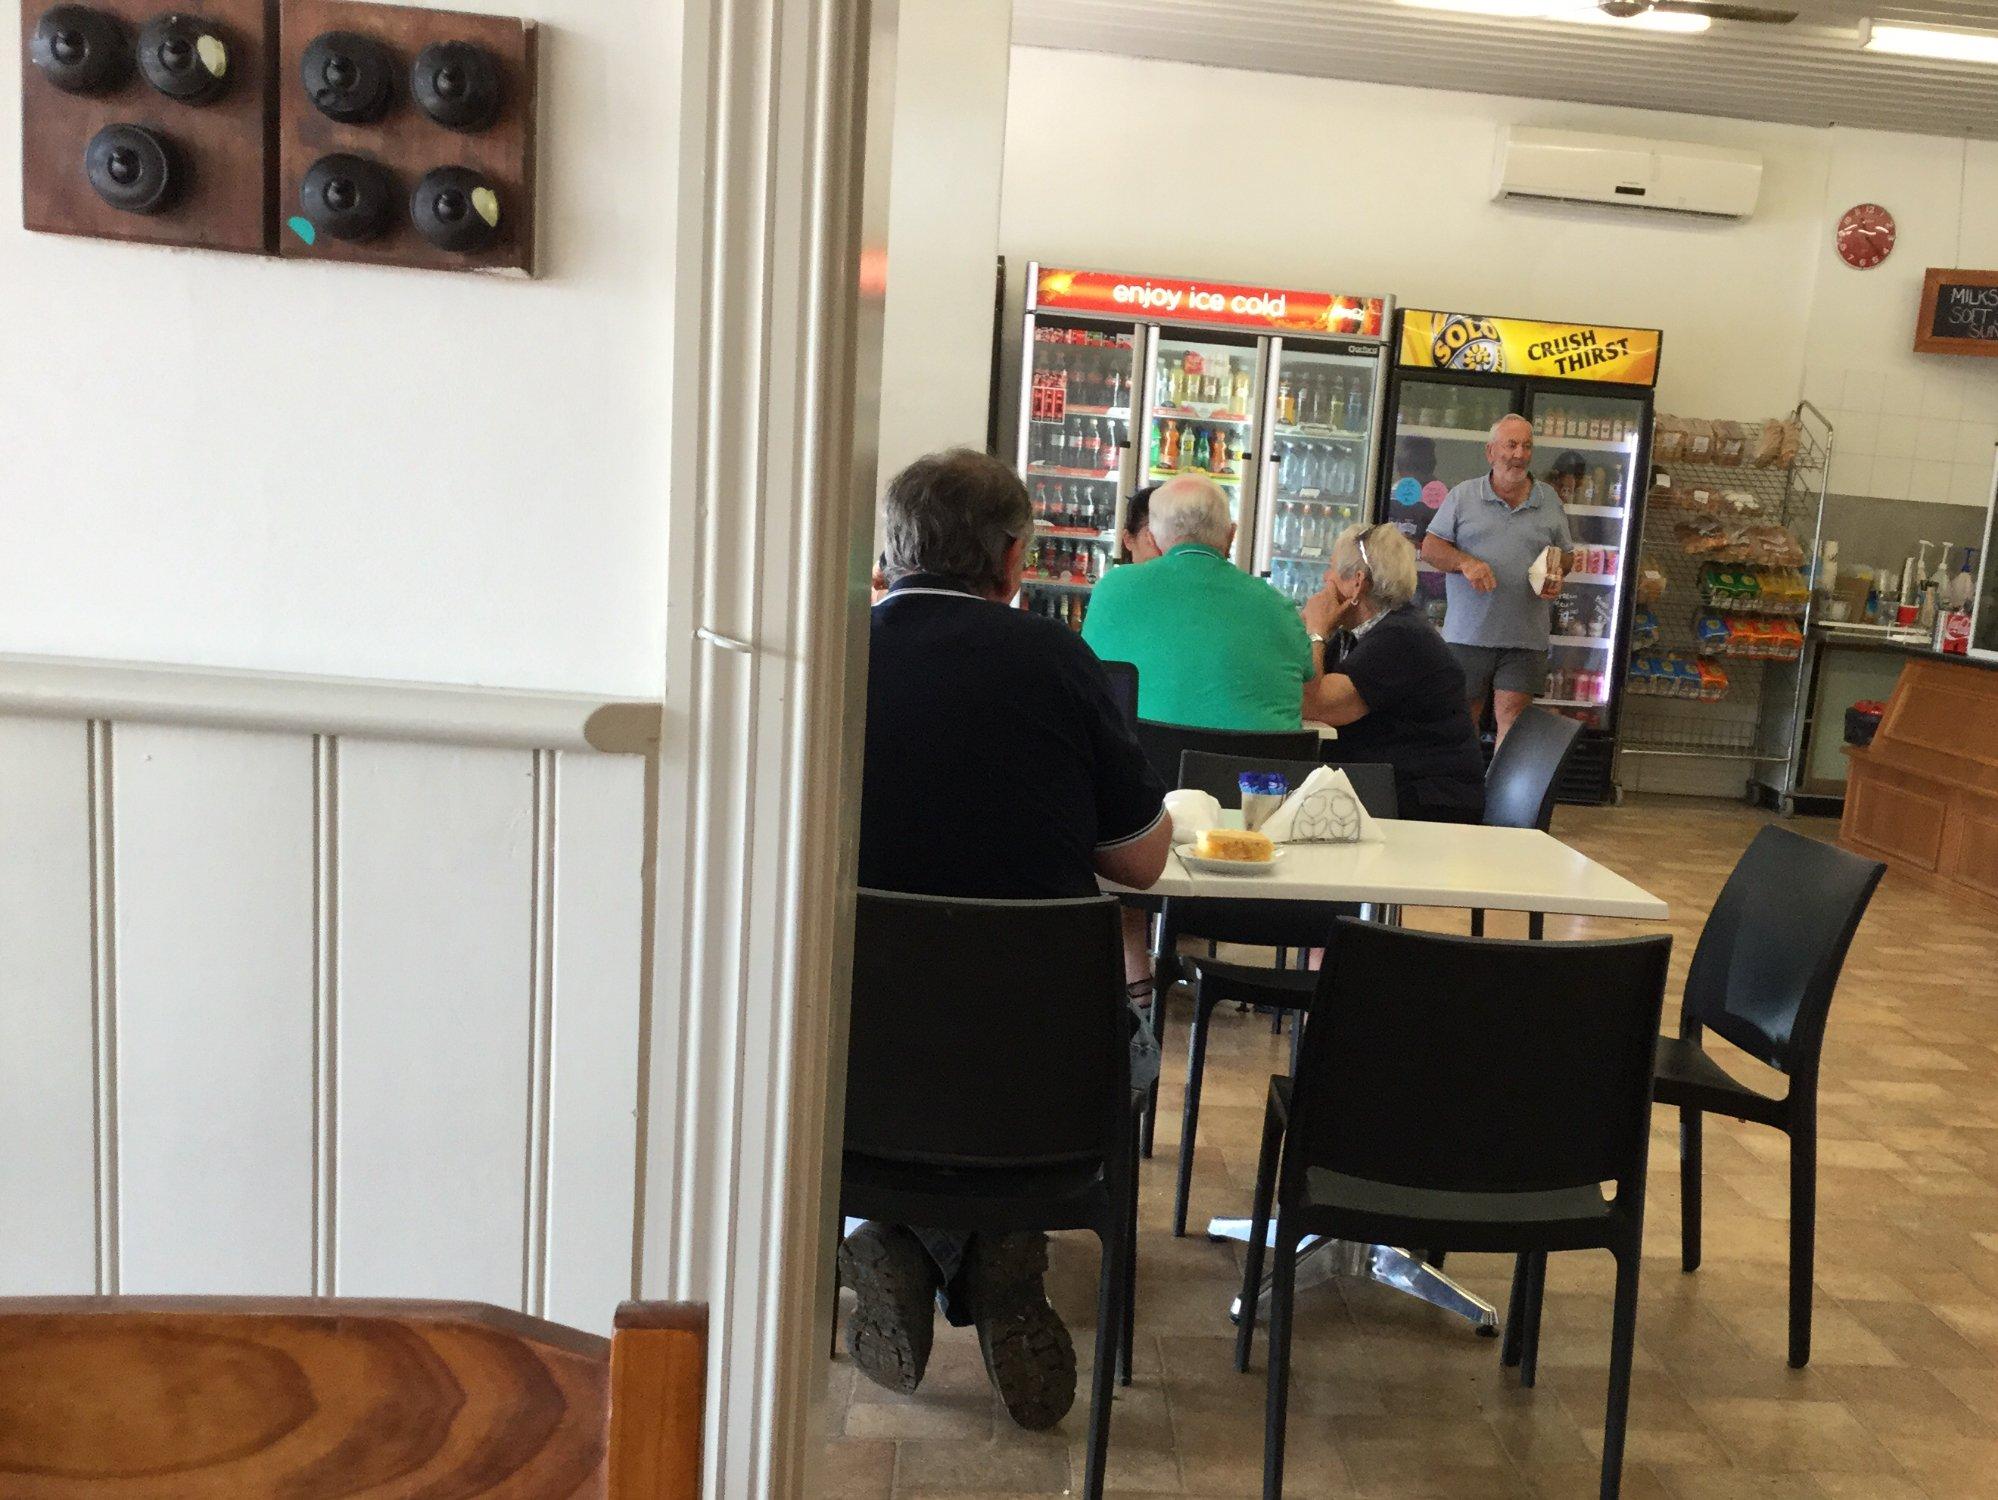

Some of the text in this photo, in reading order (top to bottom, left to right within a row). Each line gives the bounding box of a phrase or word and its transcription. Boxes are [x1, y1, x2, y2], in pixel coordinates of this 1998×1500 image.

[1113, 281, 1286, 318] enjoy ice cold
[1434, 319, 1498, 363] SOLO
[1527, 329, 1597, 361] CRUSH
[1554, 337, 1630, 375] THIRST
